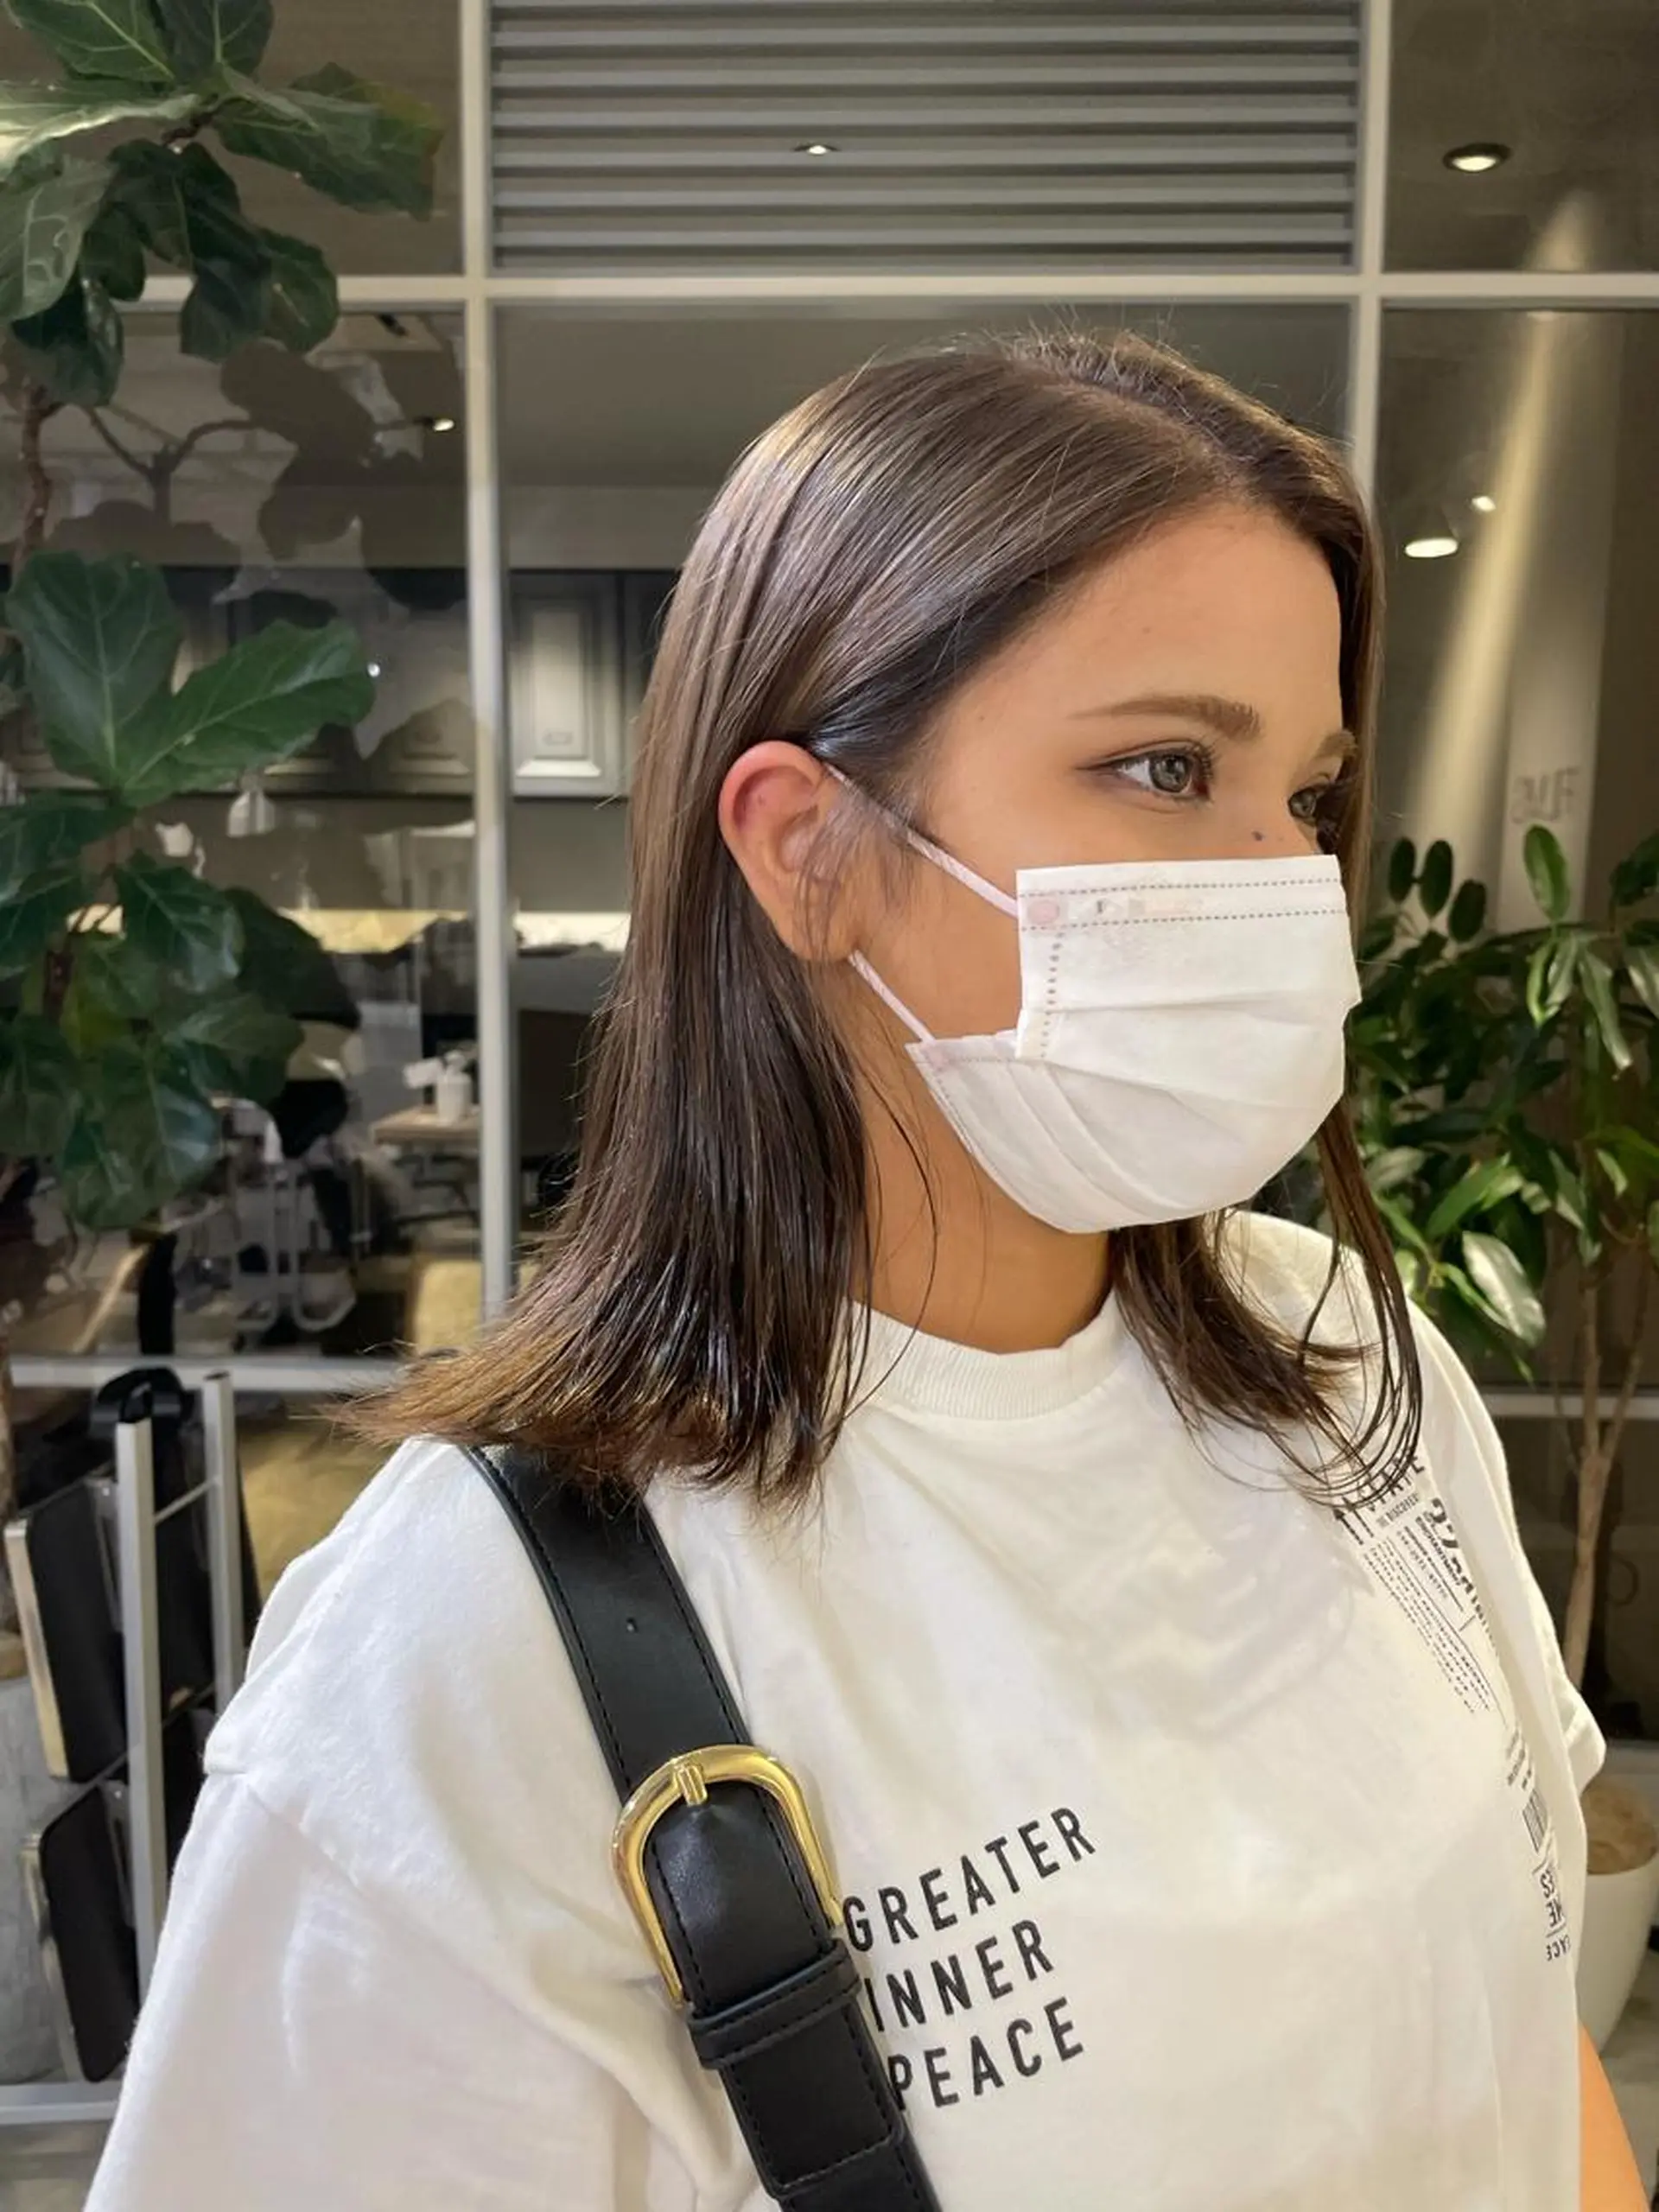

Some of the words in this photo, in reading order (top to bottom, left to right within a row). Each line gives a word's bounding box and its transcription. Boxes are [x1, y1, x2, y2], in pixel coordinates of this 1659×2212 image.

[842, 1807, 1096, 1952] GREATER
[864, 1919, 1054, 2032] INNER
[887, 1997, 1084, 2111] PEACE
